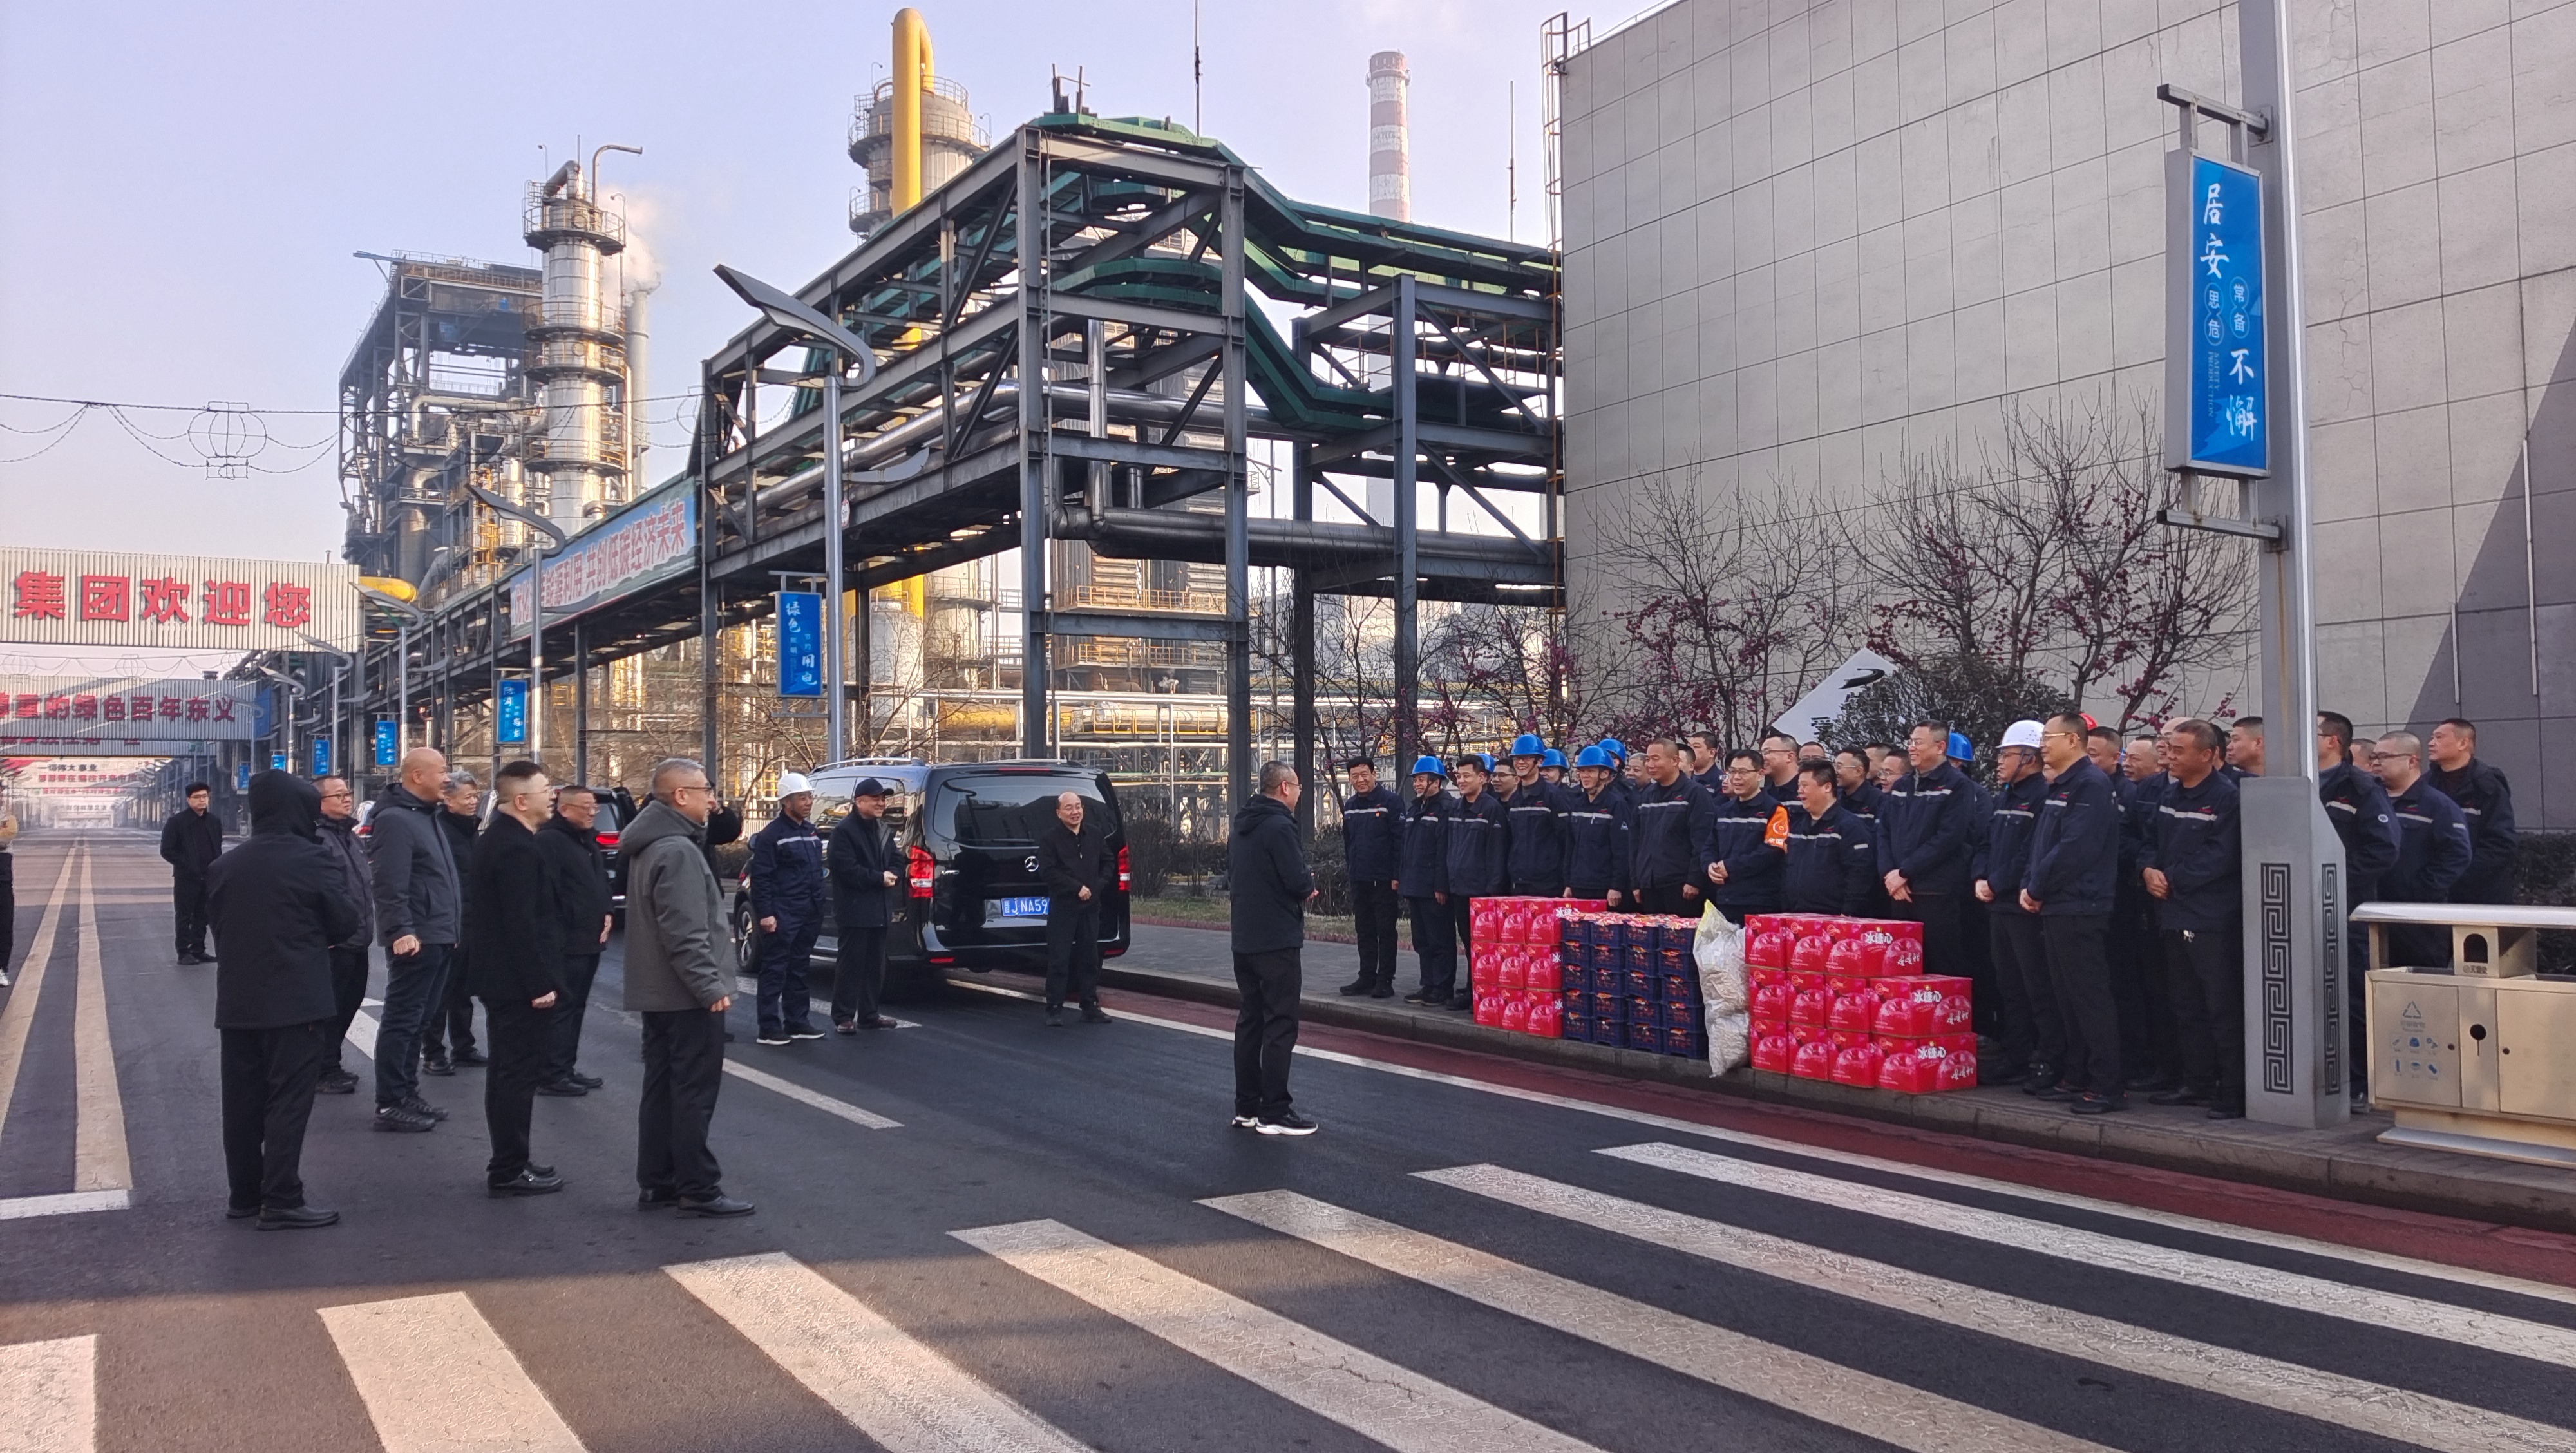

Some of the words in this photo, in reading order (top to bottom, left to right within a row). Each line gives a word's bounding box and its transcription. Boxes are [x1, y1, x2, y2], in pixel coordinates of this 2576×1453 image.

[2200, 183, 2230, 339] 居安思危
[2226, 283, 2257, 441] 常备不懈
[587, 502, 685, 591] 共创低碳经济未来
[15, 571, 311, 628] 集团欢迎您
[1865, 932, 1893, 944] 冰糖心
[1913, 990, 1942, 1003] 冰糖心
[1918, 1046, 1947, 1059] 冰糖心
